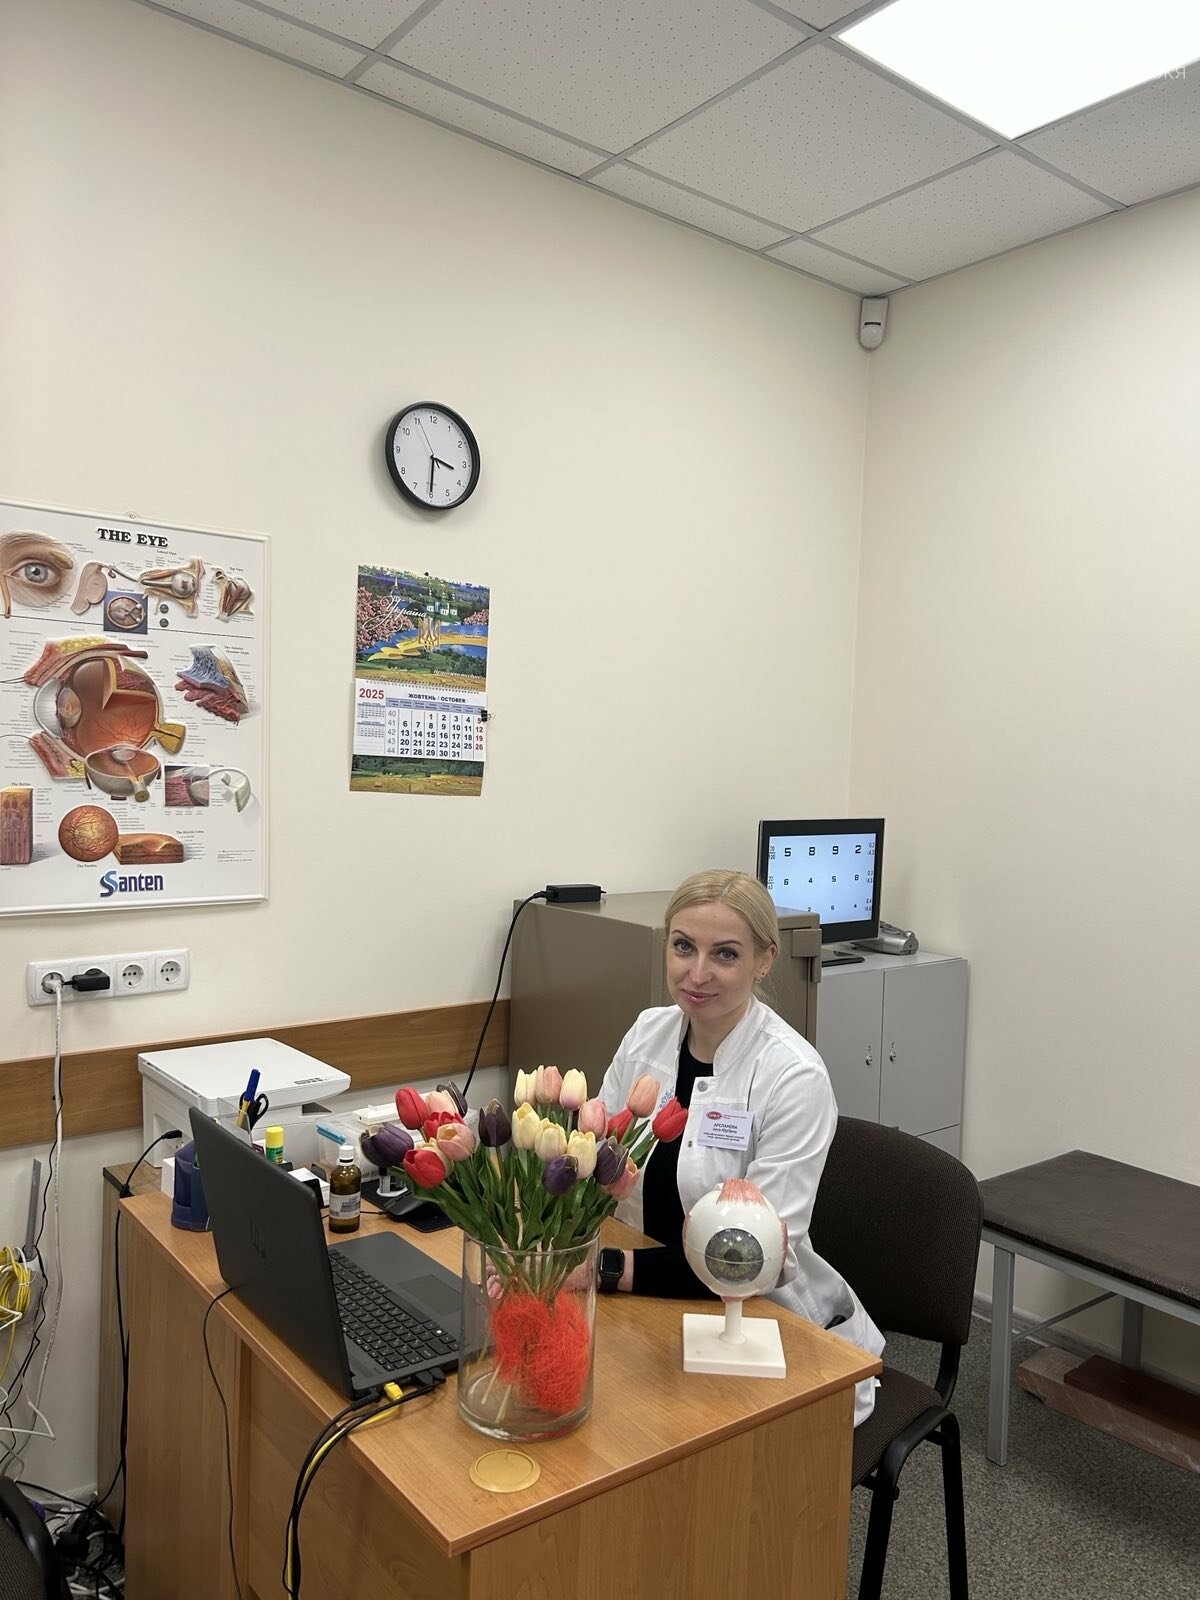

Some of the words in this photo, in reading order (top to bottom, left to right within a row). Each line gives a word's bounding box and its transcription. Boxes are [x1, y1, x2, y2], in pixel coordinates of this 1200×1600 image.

[98, 528, 132, 542] THE
[136, 533, 168, 547] EYE
[359, 688, 385, 700] 2025
[784, 848, 791, 857] 5
[809, 847, 815, 856] 8
[832, 846, 838, 855] 9
[855, 845, 861, 854] 2
[100, 870, 164, 897] Santen
